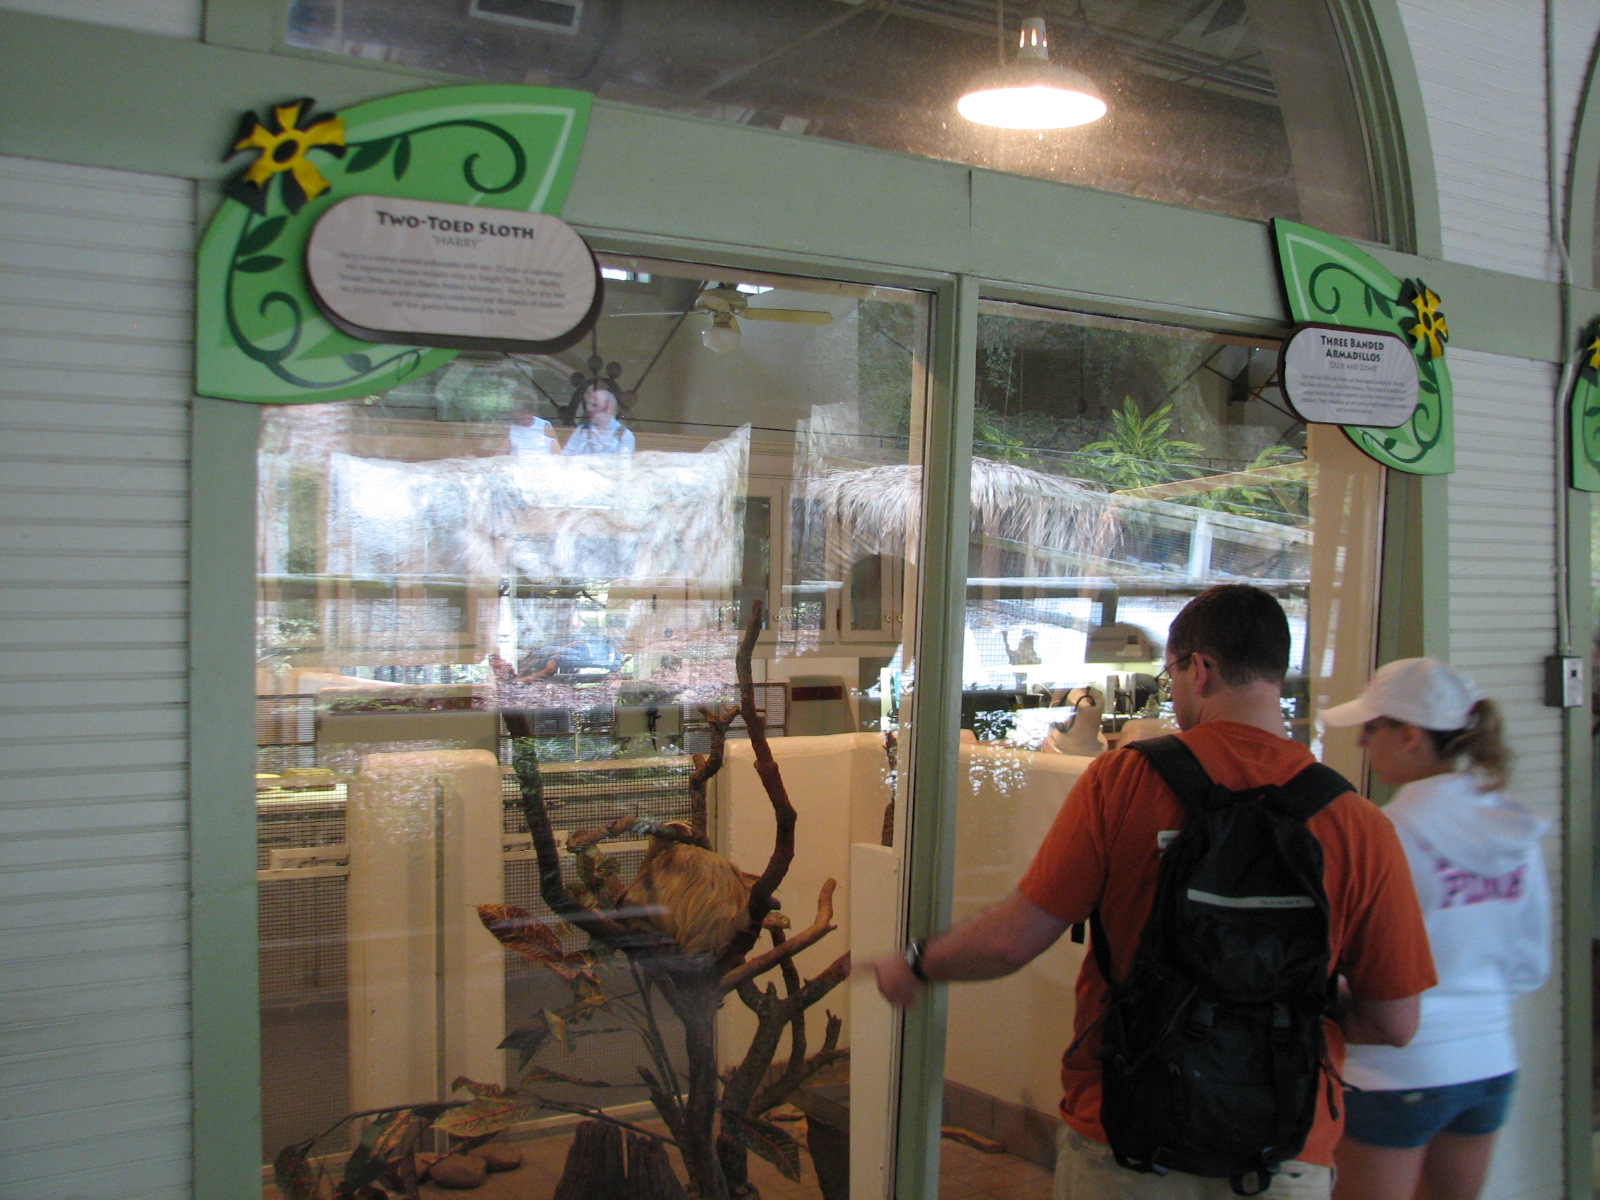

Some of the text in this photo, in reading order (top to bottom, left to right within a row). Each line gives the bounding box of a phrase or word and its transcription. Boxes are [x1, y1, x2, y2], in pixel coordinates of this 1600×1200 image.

[376, 210, 534, 240] TWO-TOED SLOTH
[1320, 335, 1384, 350] THREE BANDED
[1326, 348, 1381, 362] ARMADILLOS
